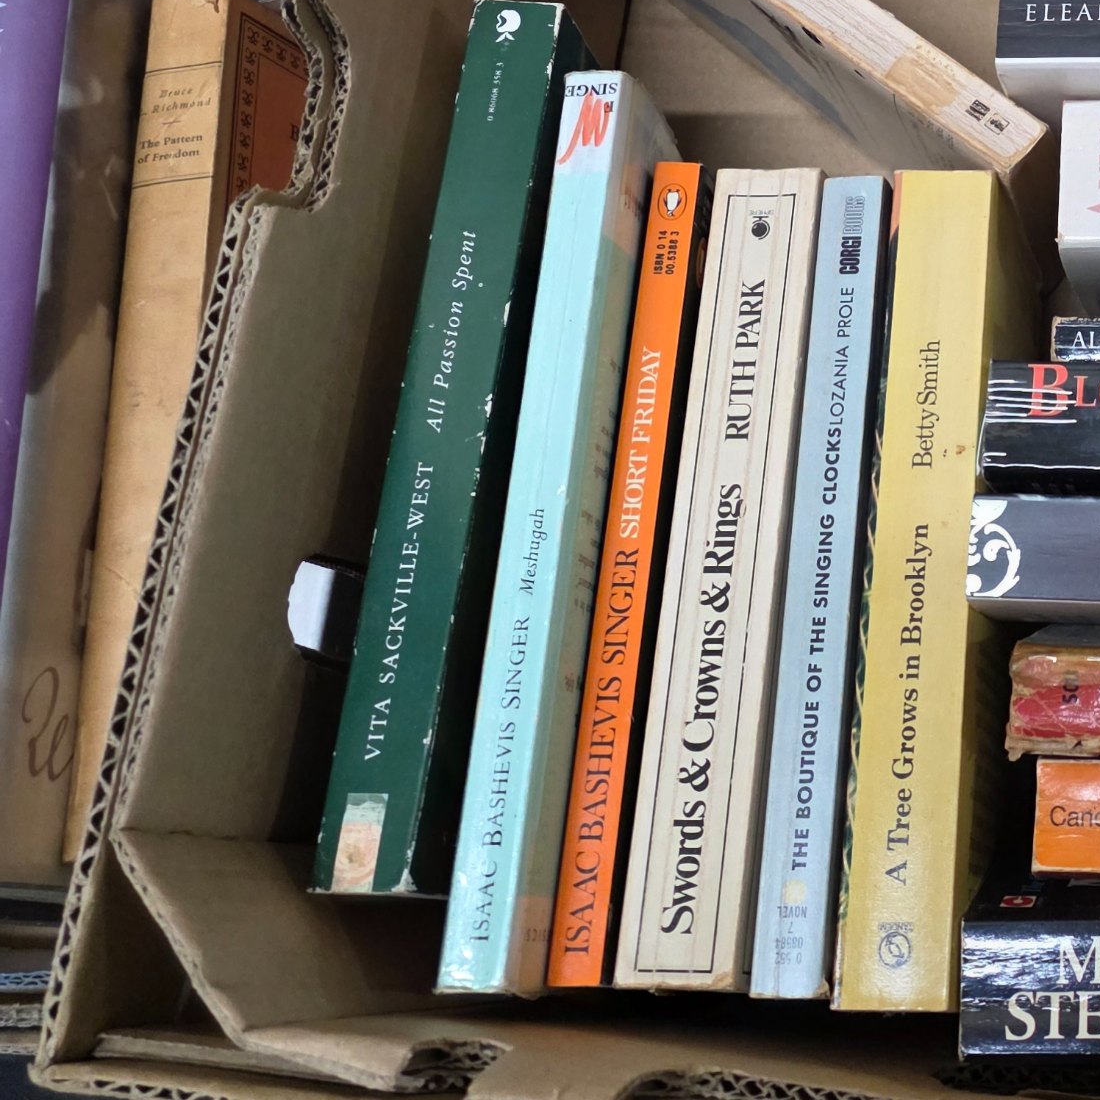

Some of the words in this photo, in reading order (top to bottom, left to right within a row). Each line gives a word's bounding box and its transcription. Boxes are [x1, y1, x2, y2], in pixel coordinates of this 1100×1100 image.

[152, 98, 212, 115] Richmond
[159, 87, 193, 98] Bruce
[137, 152, 149, 165] of
[139, 139, 160, 150] The
[163, 133, 203, 145] Pattern
[452, 230, 476, 291] Spent
[838, 235, 862, 275] CORGI
[433, 301, 464, 389] Passion
[735, 278, 766, 350] PARK
[837, 287, 855, 338] PROLE
[631, 345, 662, 444] FRIDAY
[725, 359, 757, 441] RUTH
[829, 345, 850, 426] LOZANIA
[915, 339, 941, 405] Smith
[427, 398, 446, 433] All
[911, 409, 940, 470] Betty
[619, 449, 648, 538] SHORT
[822, 427, 842, 505] CLOCKS
[378, 462, 433, 684] SACKVILLE-WEST
[519, 508, 548, 596] Meshugah
[813, 514, 835, 608] SINGING
[501, 617, 530, 710] SINGER
[809, 616, 827, 655] THE
[806, 662, 823, 692] OF
[364, 697, 391, 761] VITA
[796, 701, 820, 819] BOUTIQUE
[482, 721, 516, 848] BASHEVIS
[792, 828, 810, 871] THE
[470, 859, 497, 942] ISAAC
[777, 905, 807, 918] NOVEL
